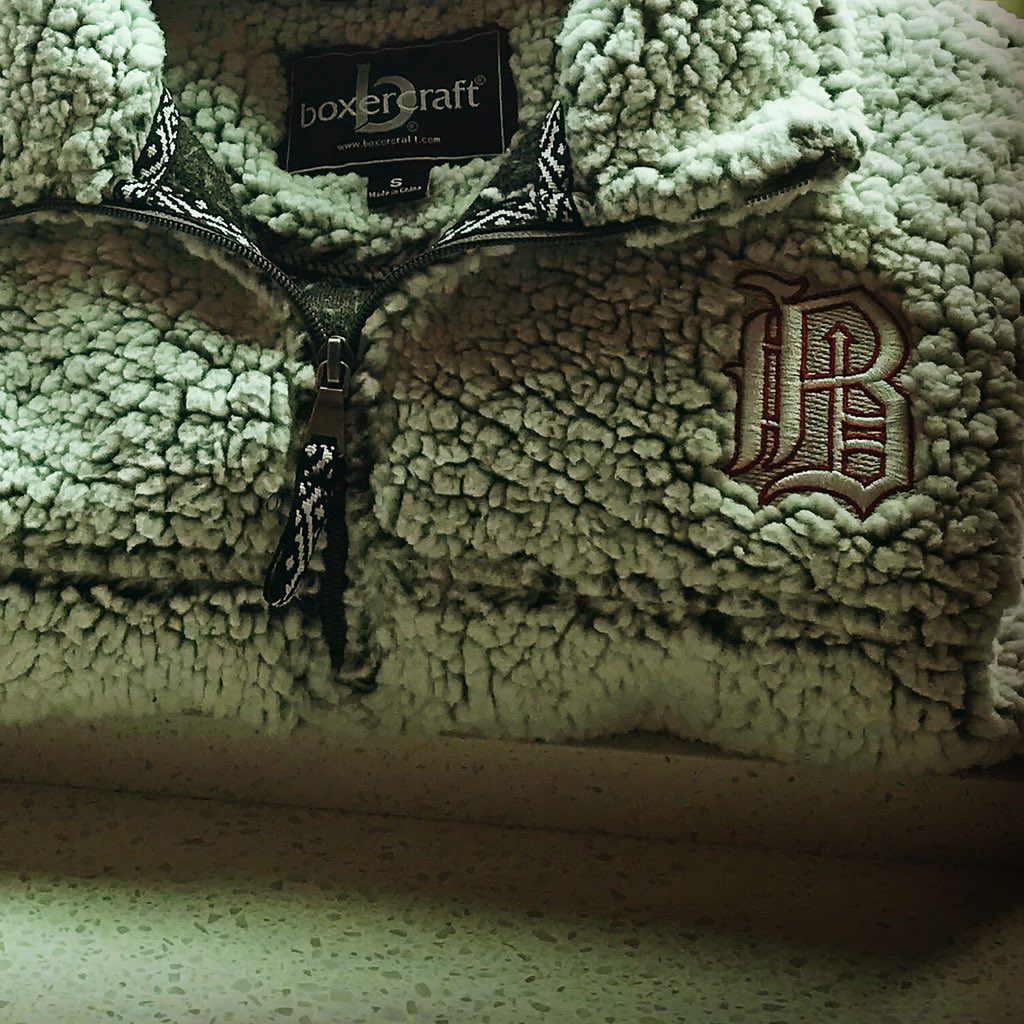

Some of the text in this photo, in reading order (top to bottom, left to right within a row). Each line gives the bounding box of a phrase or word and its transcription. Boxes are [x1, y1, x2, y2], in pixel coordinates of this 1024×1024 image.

[300, 79, 480, 128] boxercraft
[336, 135, 442, 151] www.boxercraft.com
[389, 177, 403, 188] S
[368, 189, 390, 198] Made
[399, 185, 423, 194] China
[723, 268, 916, 522] B
